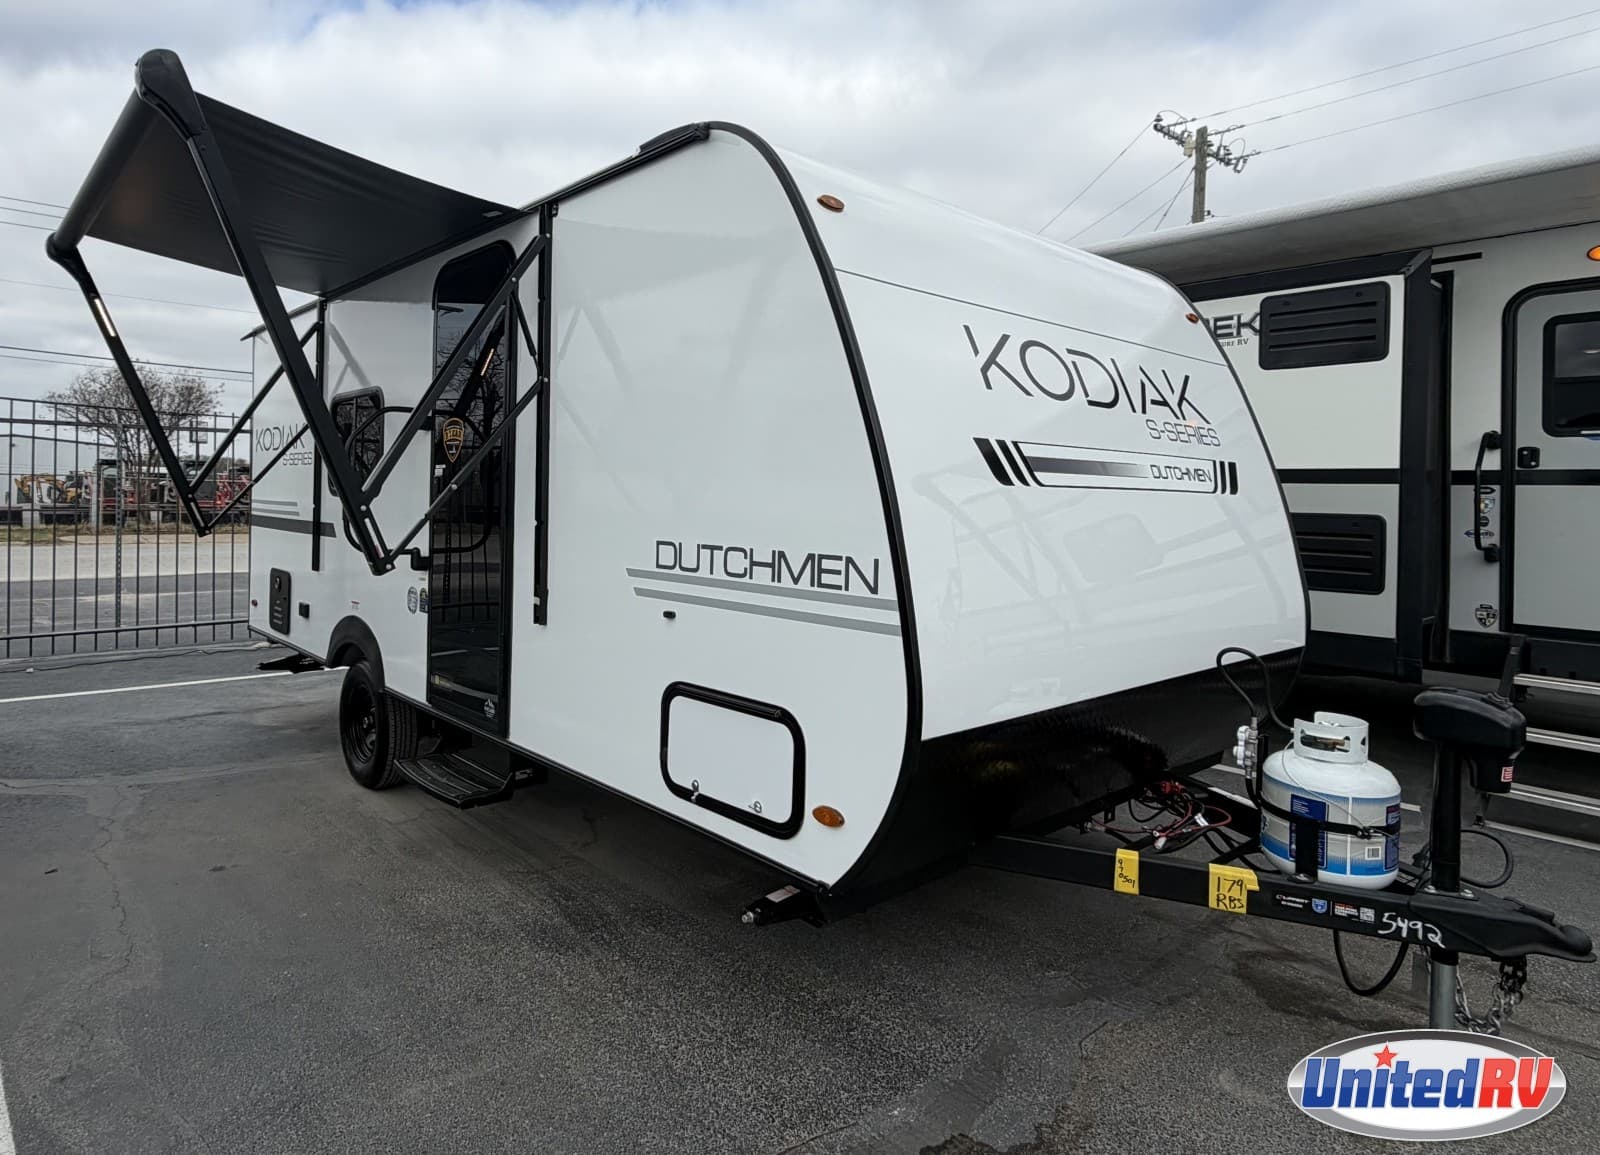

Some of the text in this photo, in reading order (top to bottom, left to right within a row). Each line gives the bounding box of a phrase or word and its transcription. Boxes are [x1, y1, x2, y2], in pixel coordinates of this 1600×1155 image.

[963, 324, 1211, 425] KODIAK
[1145, 418, 1221, 447] S-SERIES
[1150, 464, 1213, 482] DUTCHMEN
[655, 540, 880, 595] DUTCHMEN
[1216, 877, 1245, 896] 179
[1216, 894, 1245, 911] RBS
[1377, 912, 1446, 949] 5492
